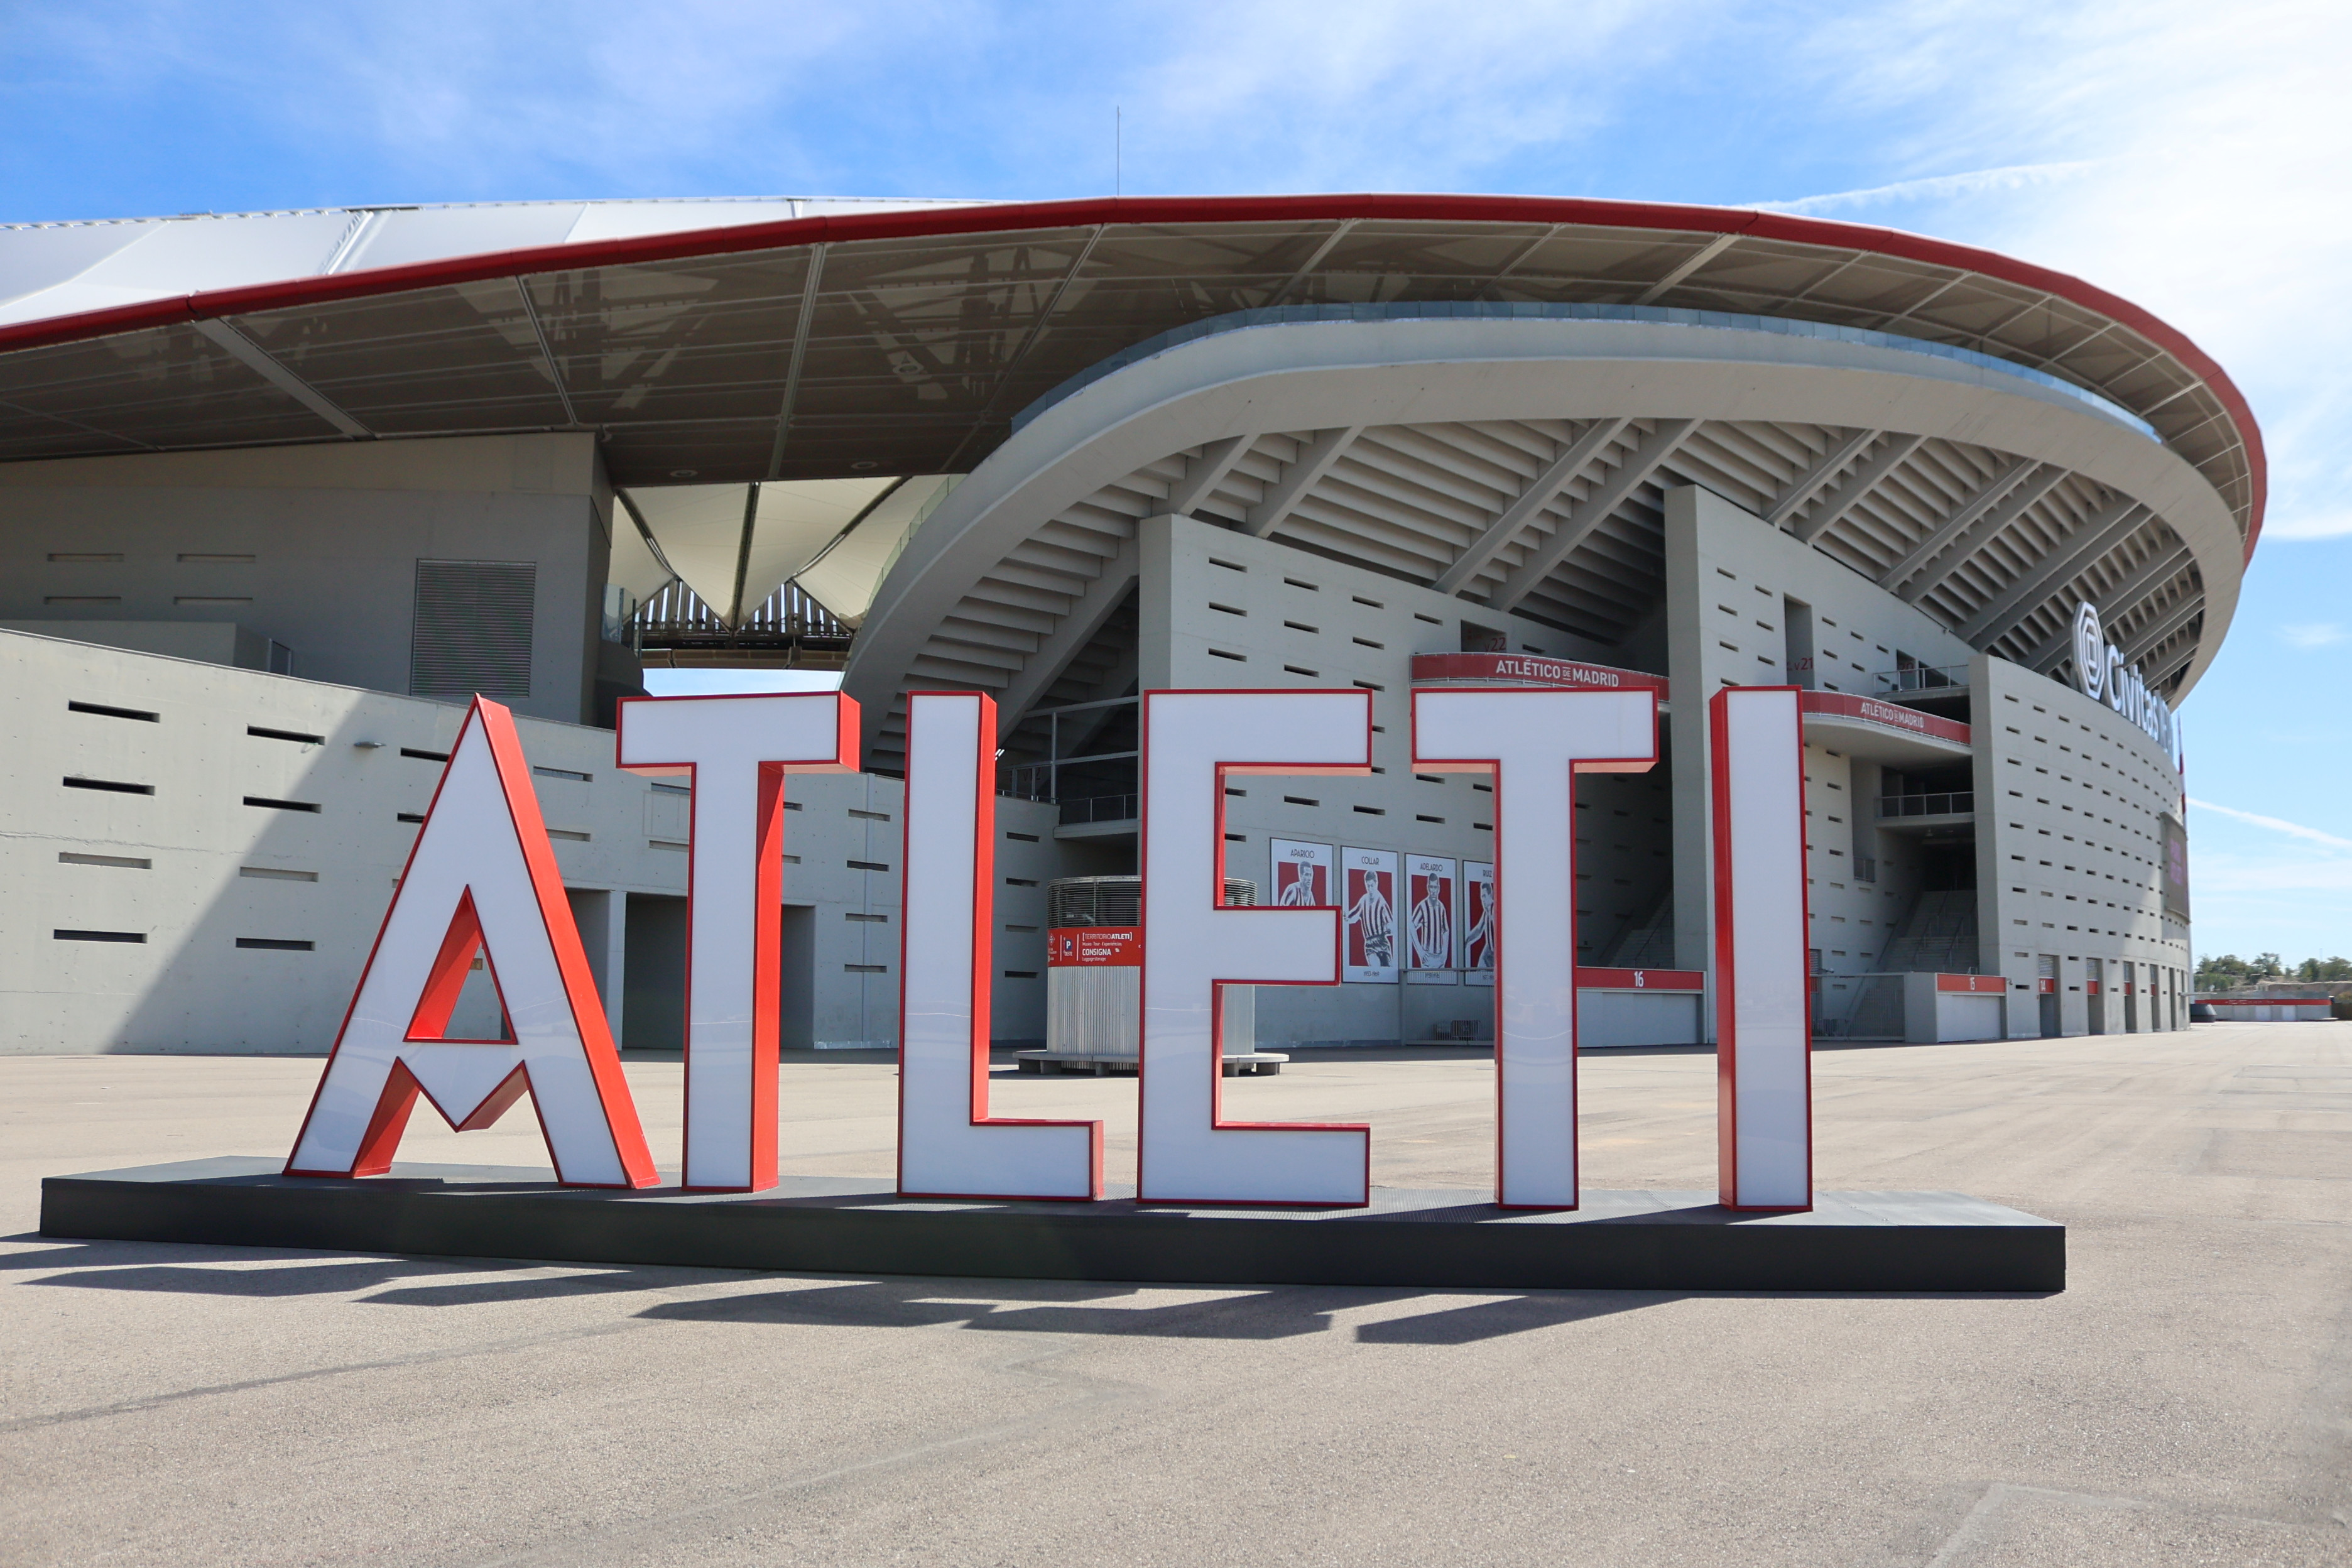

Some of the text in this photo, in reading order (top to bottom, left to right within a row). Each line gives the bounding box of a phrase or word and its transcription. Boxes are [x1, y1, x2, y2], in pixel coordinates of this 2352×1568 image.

[1496, 659, 1560, 679] ATLÉTICO
[1573, 668, 1619, 687] MADRID
[2104, 644, 2159, 742] Civitas
[1861, 702, 1893, 721] ATLÉTICO
[1898, 711, 1924, 728] MADRID
[1290, 849, 1315, 859] APARICIO
[1361, 856, 1380, 866] COLLAR
[1420, 863, 1443, 873] ADELARDO
[285, 686, 1814, 1211] ATLETI
[1065, 940, 1071, 949] P
[1082, 948, 1112, 956] CONSIGNA
[1634, 971, 1644, 987] 16
